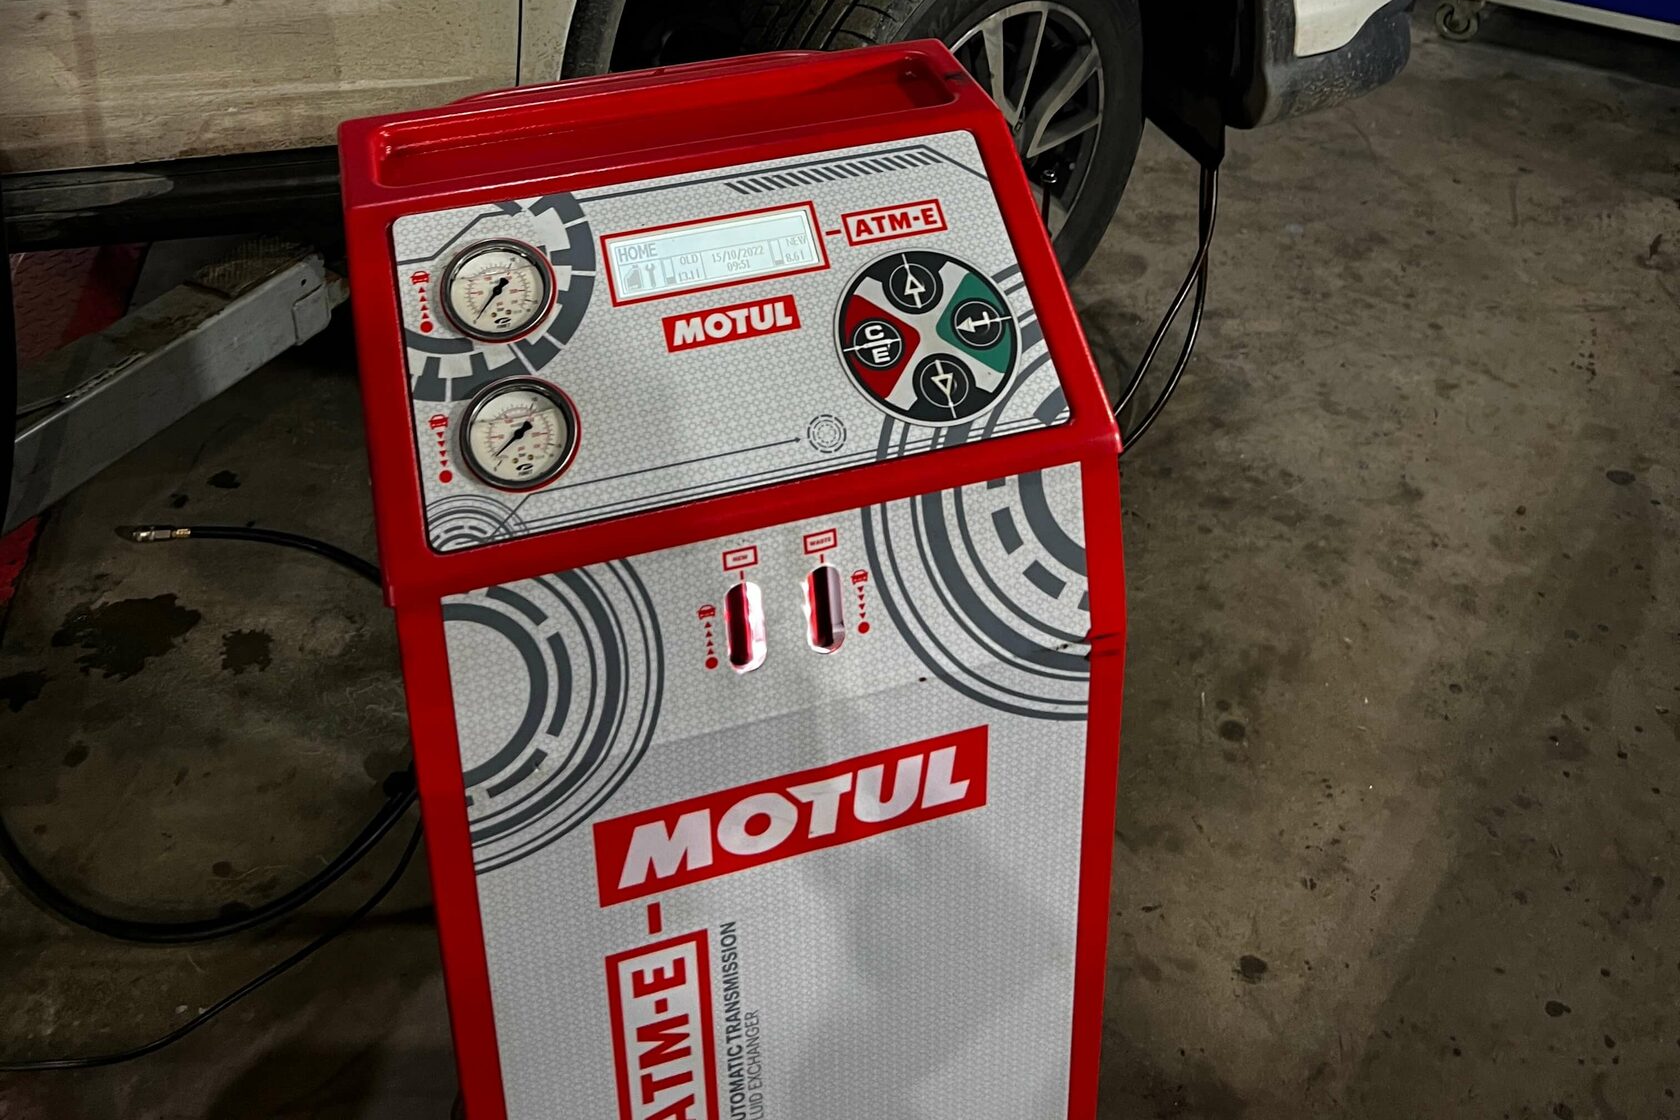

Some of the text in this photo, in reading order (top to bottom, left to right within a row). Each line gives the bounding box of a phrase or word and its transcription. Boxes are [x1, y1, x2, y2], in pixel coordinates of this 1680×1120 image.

[856, 208, 938, 237] ATM-E
[786, 234, 807, 247] NEW
[618, 243, 658, 262] HOME
[680, 254, 699, 265] OLD
[712, 245, 765, 263] 15/10/2022
[727, 259, 751, 272] 09:51
[673, 301, 793, 347] MOTUL
[865, 324, 885, 340] C
[872, 347, 891, 363] E
[617, 745, 971, 890] MOTUL
[720, 921, 742, 1044] TRANSMISSION
[744, 1009, 762, 1091] EXCHANGER
